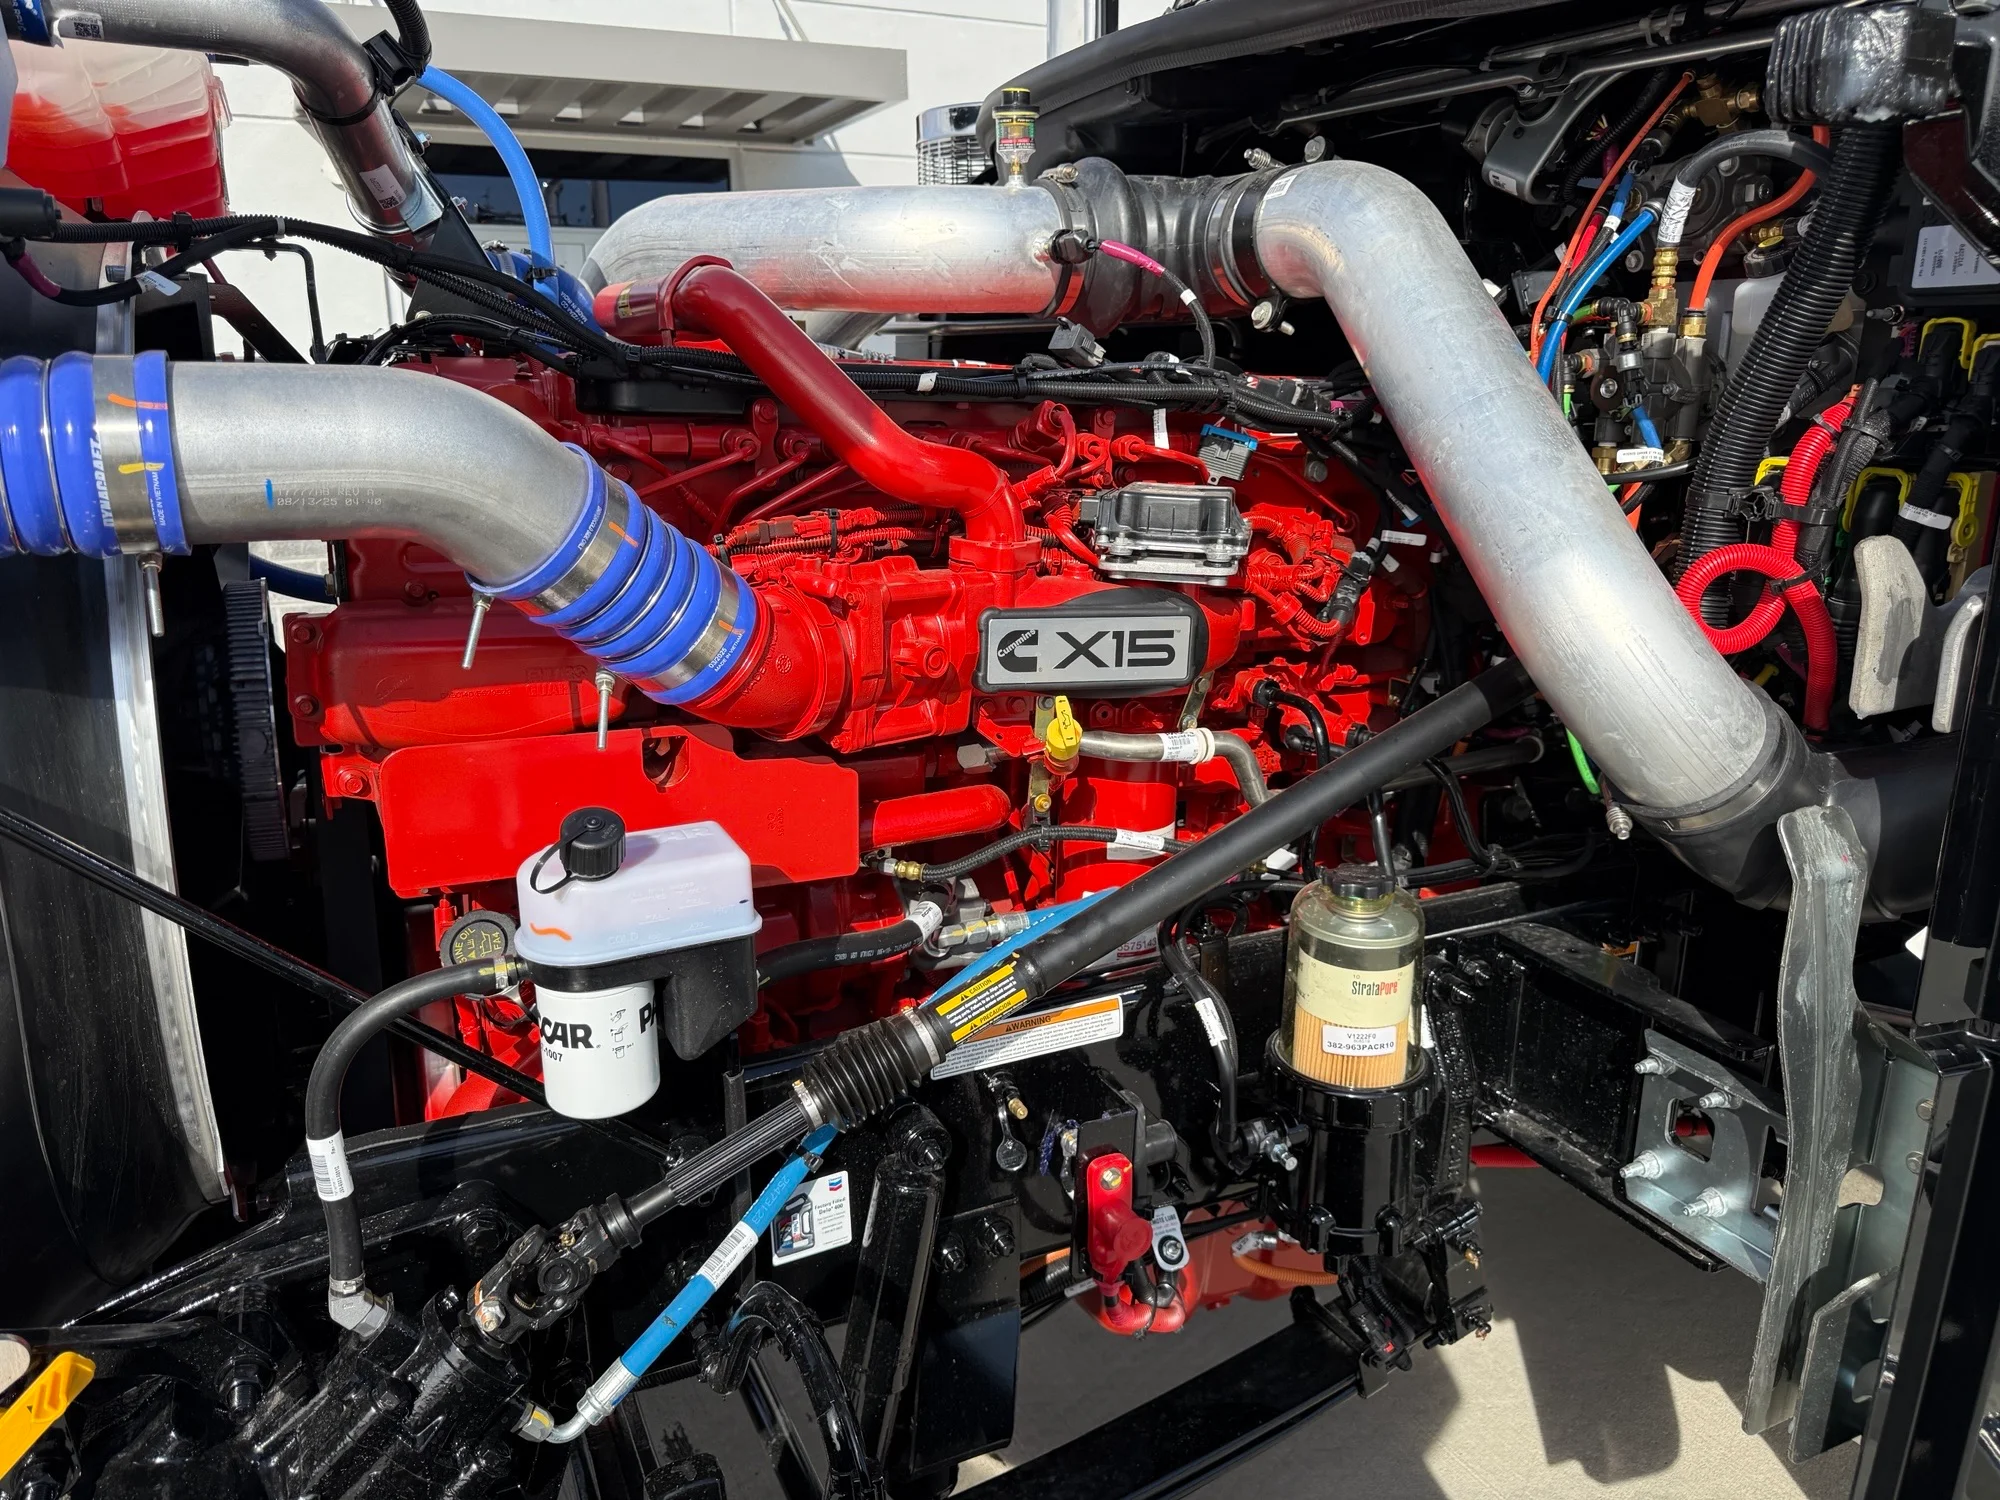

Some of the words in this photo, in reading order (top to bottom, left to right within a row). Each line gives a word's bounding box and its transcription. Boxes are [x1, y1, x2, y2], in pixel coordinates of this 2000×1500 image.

[151, 471, 161, 500] VIETNAM
[157, 509, 165, 525] MADE
[714, 657, 727, 672] MADE
[730, 634, 743, 652] VIETNAM
[997, 629, 1036, 658] Cummins
[1053, 630, 1176, 669] X15
[708, 647, 727, 668] 03/2025
[460, 928, 476, 940] OIL
[493, 932, 502, 950] FA4
[969, 978, 991, 994] CAUTION
[1351, 980, 1398, 996] StrataPore
[1011, 1015, 1051, 1030] WARNING
[540, 1016, 595, 1049] CAR
